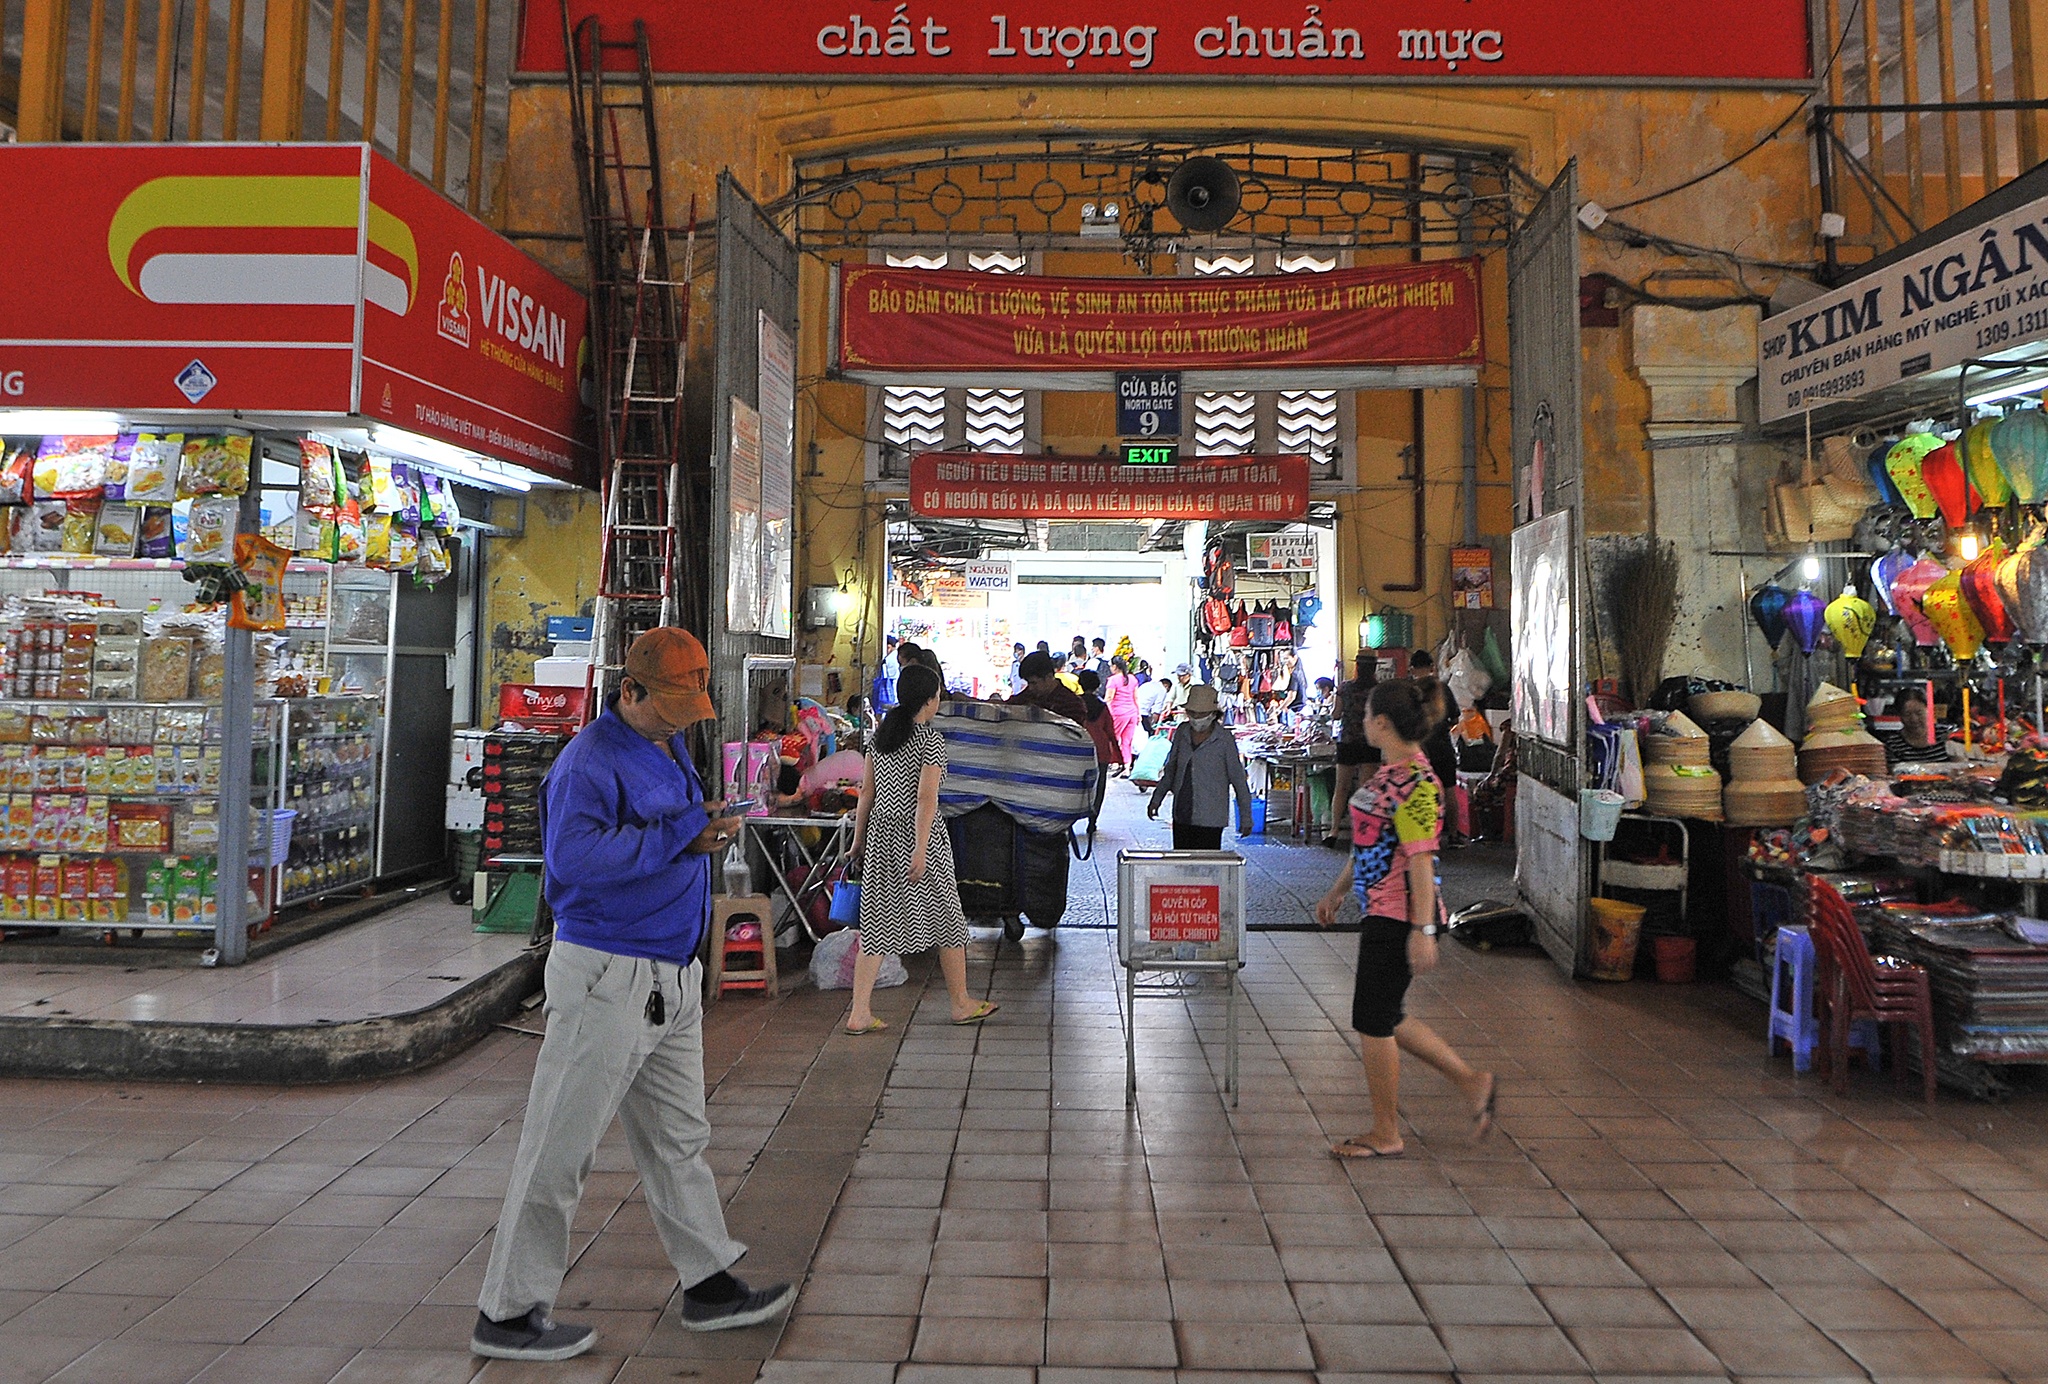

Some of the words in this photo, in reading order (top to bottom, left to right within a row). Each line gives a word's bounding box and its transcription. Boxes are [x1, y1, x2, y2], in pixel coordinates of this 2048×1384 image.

[817, 4, 951, 57] chất
[988, 15, 1158, 69] lượng
[1194, 4, 1365, 59] chuẩn
[1398, 28, 1504, 70] mực
[868, 280, 901, 314] BẢO
[905, 282, 940, 315] ĐẢM
[944, 282, 984, 315] CHẤT
[989, 288, 1046, 321] LƯỢNG,
[1051, 286, 1070, 321] VỆ
[1075, 291, 1112, 315] SINH
[1116, 292, 1138, 315] AN
[1142, 286, 1184, 314] TOÀN
[1187, 286, 1231, 321] THỰC
[1235, 281, 1281, 314] PHẨM
[1285, 283, 1317, 312] VỪA
[1321, 282, 1341, 312] LÀ
[1346, 277, 1398, 310] TRÁCH
[1403, 276, 1455, 314] NHIỆM
[1787, 286, 1883, 360] KIM
[1900, 217, 2048, 318] NGÂN
[442, 316, 468, 340] VISSAN
[477, 265, 566, 369] VISSAN
[1013, 324, 1045, 355] VỪA
[1049, 326, 1069, 354] LÀ
[1074, 320, 1126, 358] QUYỀN
[1131, 327, 1156, 359] LỢI
[1161, 320, 1194, 353] CỦA
[1197, 326, 1261, 353] THƯƠNG
[1265, 321, 1309, 352] NHÂN
[1762, 334, 1787, 360] SHOP
[1780, 357, 1830, 386] CHUYÊN
[1833, 345, 1862, 368] BÁN
[1865, 331, 1903, 357] HÀNG
[1906, 317, 1931, 343] MỸ
[1121, 375, 1147, 397] CỬA
[1151, 374, 1177, 397] BẮC
[1124, 399, 1151, 411] NORTH
[1152, 399, 1174, 410] GATE
[415, 404, 426, 425] TỰ
[425, 406, 440, 426] HÀO
[440, 411, 458, 432] HÀNG
[459, 419, 472, 439] VIỆT
[472, 424, 486, 441] NAM
[1139, 411, 1160, 436] 9
[1128, 448, 1171, 463] EXIT
[936, 460, 975, 482] NGƯỜI
[979, 461, 1009, 482] TIÊU
[1012, 461, 1047, 482] DÙNG
[1050, 461, 1078, 482] NÊN
[1081, 462, 1106, 486] LỰA
[1110, 465, 1144, 486] CHỌN
[1178, 460, 1216, 483] PHẨM
[1221, 465, 1239, 483] AN
[923, 488, 940, 509] CÓ
[944, 488, 988, 510] NGUỒN
[991, 487, 1017, 510] GỐC
[1021, 489, 1039, 510] VÀ
[1044, 489, 1062, 511] ĐÃ
[1066, 493, 1092, 513] QUA
[1096, 487, 1131, 511] KIỂM
[1134, 494, 1163, 515] DỊCH
[1166, 489, 1194, 511] CỦA
[1197, 492, 1215, 512] CƠ
[1218, 493, 1253, 513] QUAN
[1257, 491, 1282, 512] THÚ
[1286, 494, 1296, 512] Y
[968, 564, 994, 574] NGÂN
[995, 564, 1008, 574] HÀ
[938, 580, 960, 588] NGỌC
[968, 576, 1009, 587] WATCH
[526, 696, 555, 711] envy
[1161, 895, 1190, 909] QUYÊN
[1190, 895, 1208, 909] GÓP
[1164, 910, 1179, 925] HỘI
[1192, 910, 1218, 926] THIỆN
[1151, 927, 1182, 940] SOCIAL
[1182, 927, 1218, 940] CHARITY
